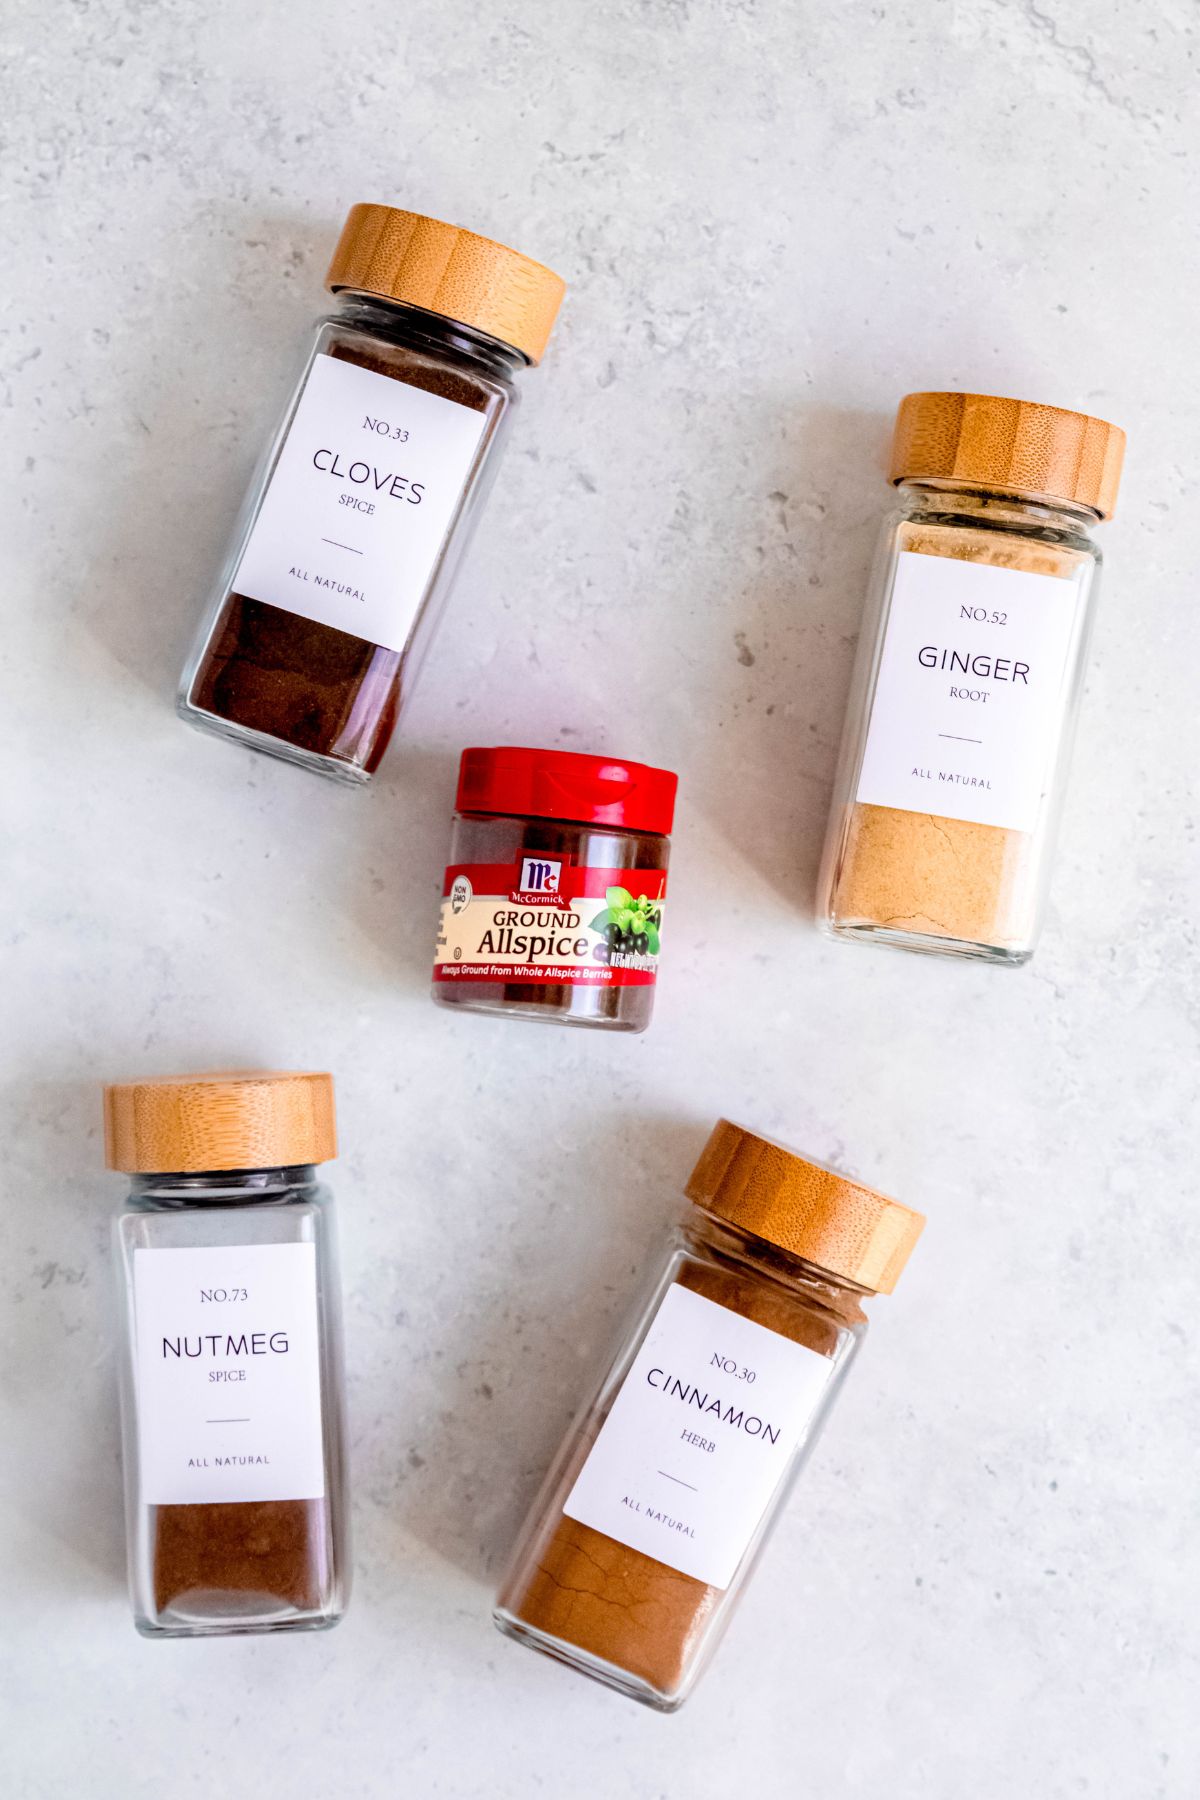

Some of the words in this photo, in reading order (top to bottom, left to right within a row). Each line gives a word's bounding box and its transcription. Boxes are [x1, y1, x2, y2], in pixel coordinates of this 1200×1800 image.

[362, 416, 410, 443] NO.33
[313, 449, 425, 505] CLOVES
[338, 494, 376, 515] SPICE
[289, 567, 308, 581] ALL
[314, 575, 366, 602] NATURAL
[959, 605, 1008, 625] NO.52
[918, 646, 1030, 684] GINGER
[949, 686, 990, 703] ROOT
[911, 767, 932, 779] ALL
[938, 772, 992, 789] NATURAL
[512, 891, 564, 905] McCormick
[493, 910, 580, 929] GROUND
[476, 928, 589, 963] Allspice
[461, 965, 489, 976] Ground
[490, 966, 512, 976] from
[514, 966, 543, 978] Whole
[545, 967, 580, 979] Allspice
[582, 969, 613, 980] Berries
[200, 1289, 248, 1302] NO.73
[163, 1332, 289, 1358] NUTMEG
[208, 1370, 247, 1382] SPICE
[709, 1352, 757, 1384] NO.30
[647, 1368, 781, 1445] CINNAMON
[680, 1429, 716, 1453] HERB
[188, 1457, 209, 1468] ALL
[215, 1455, 270, 1467] NATURAL
[621, 1496, 641, 1512] ALL
[646, 1507, 697, 1539] NATURAL
